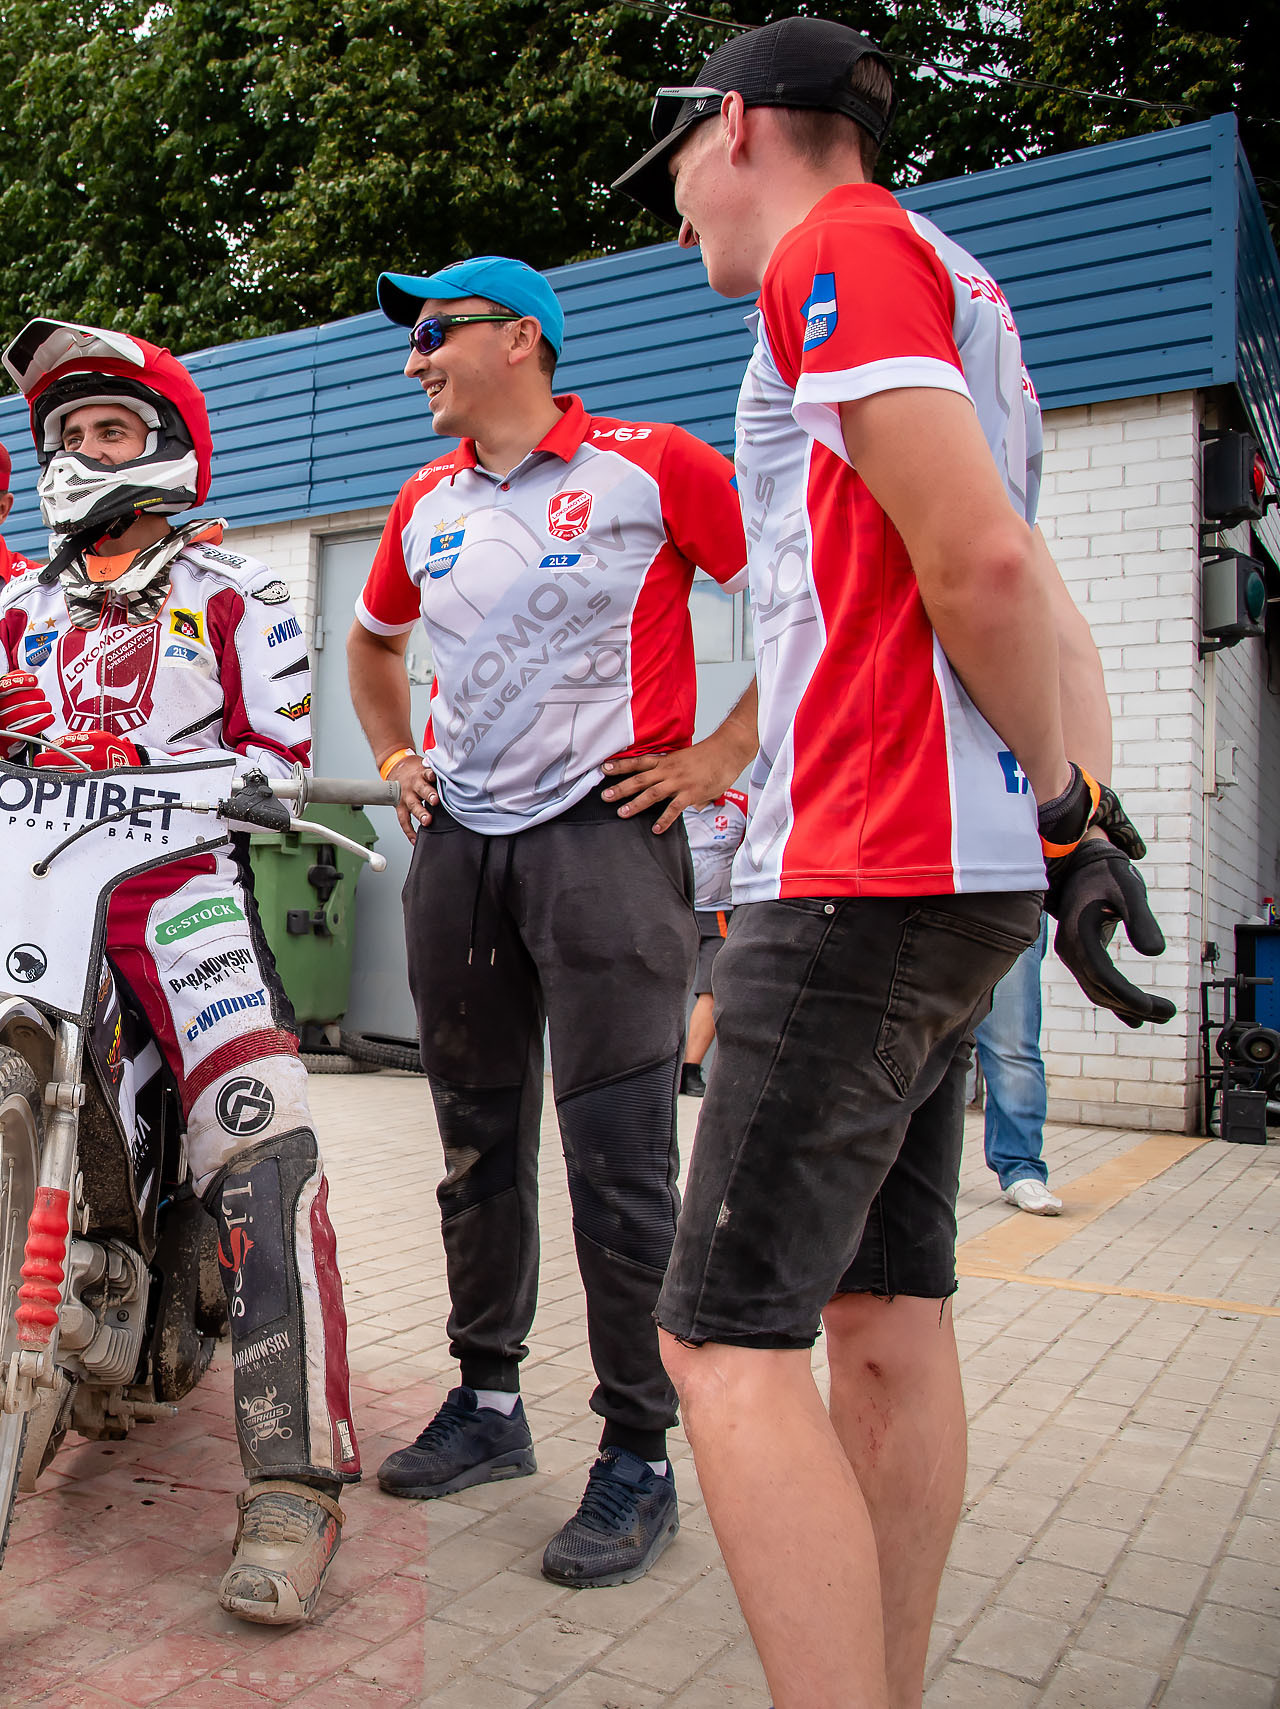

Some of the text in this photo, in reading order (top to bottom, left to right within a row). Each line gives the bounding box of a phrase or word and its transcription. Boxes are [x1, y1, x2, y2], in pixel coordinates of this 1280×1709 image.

[66, 626, 140, 682] LOKOMOT
[107, 627, 154, 663] DAUGAVPILS
[136, 636, 153, 649] CLUB
[461, 592, 612, 760] DAUGAVPILS
[108, 825, 170, 846] BĀRS
[165, 902, 235, 936] G-STOCK
[240, 1352, 282, 1376] FAMILY
